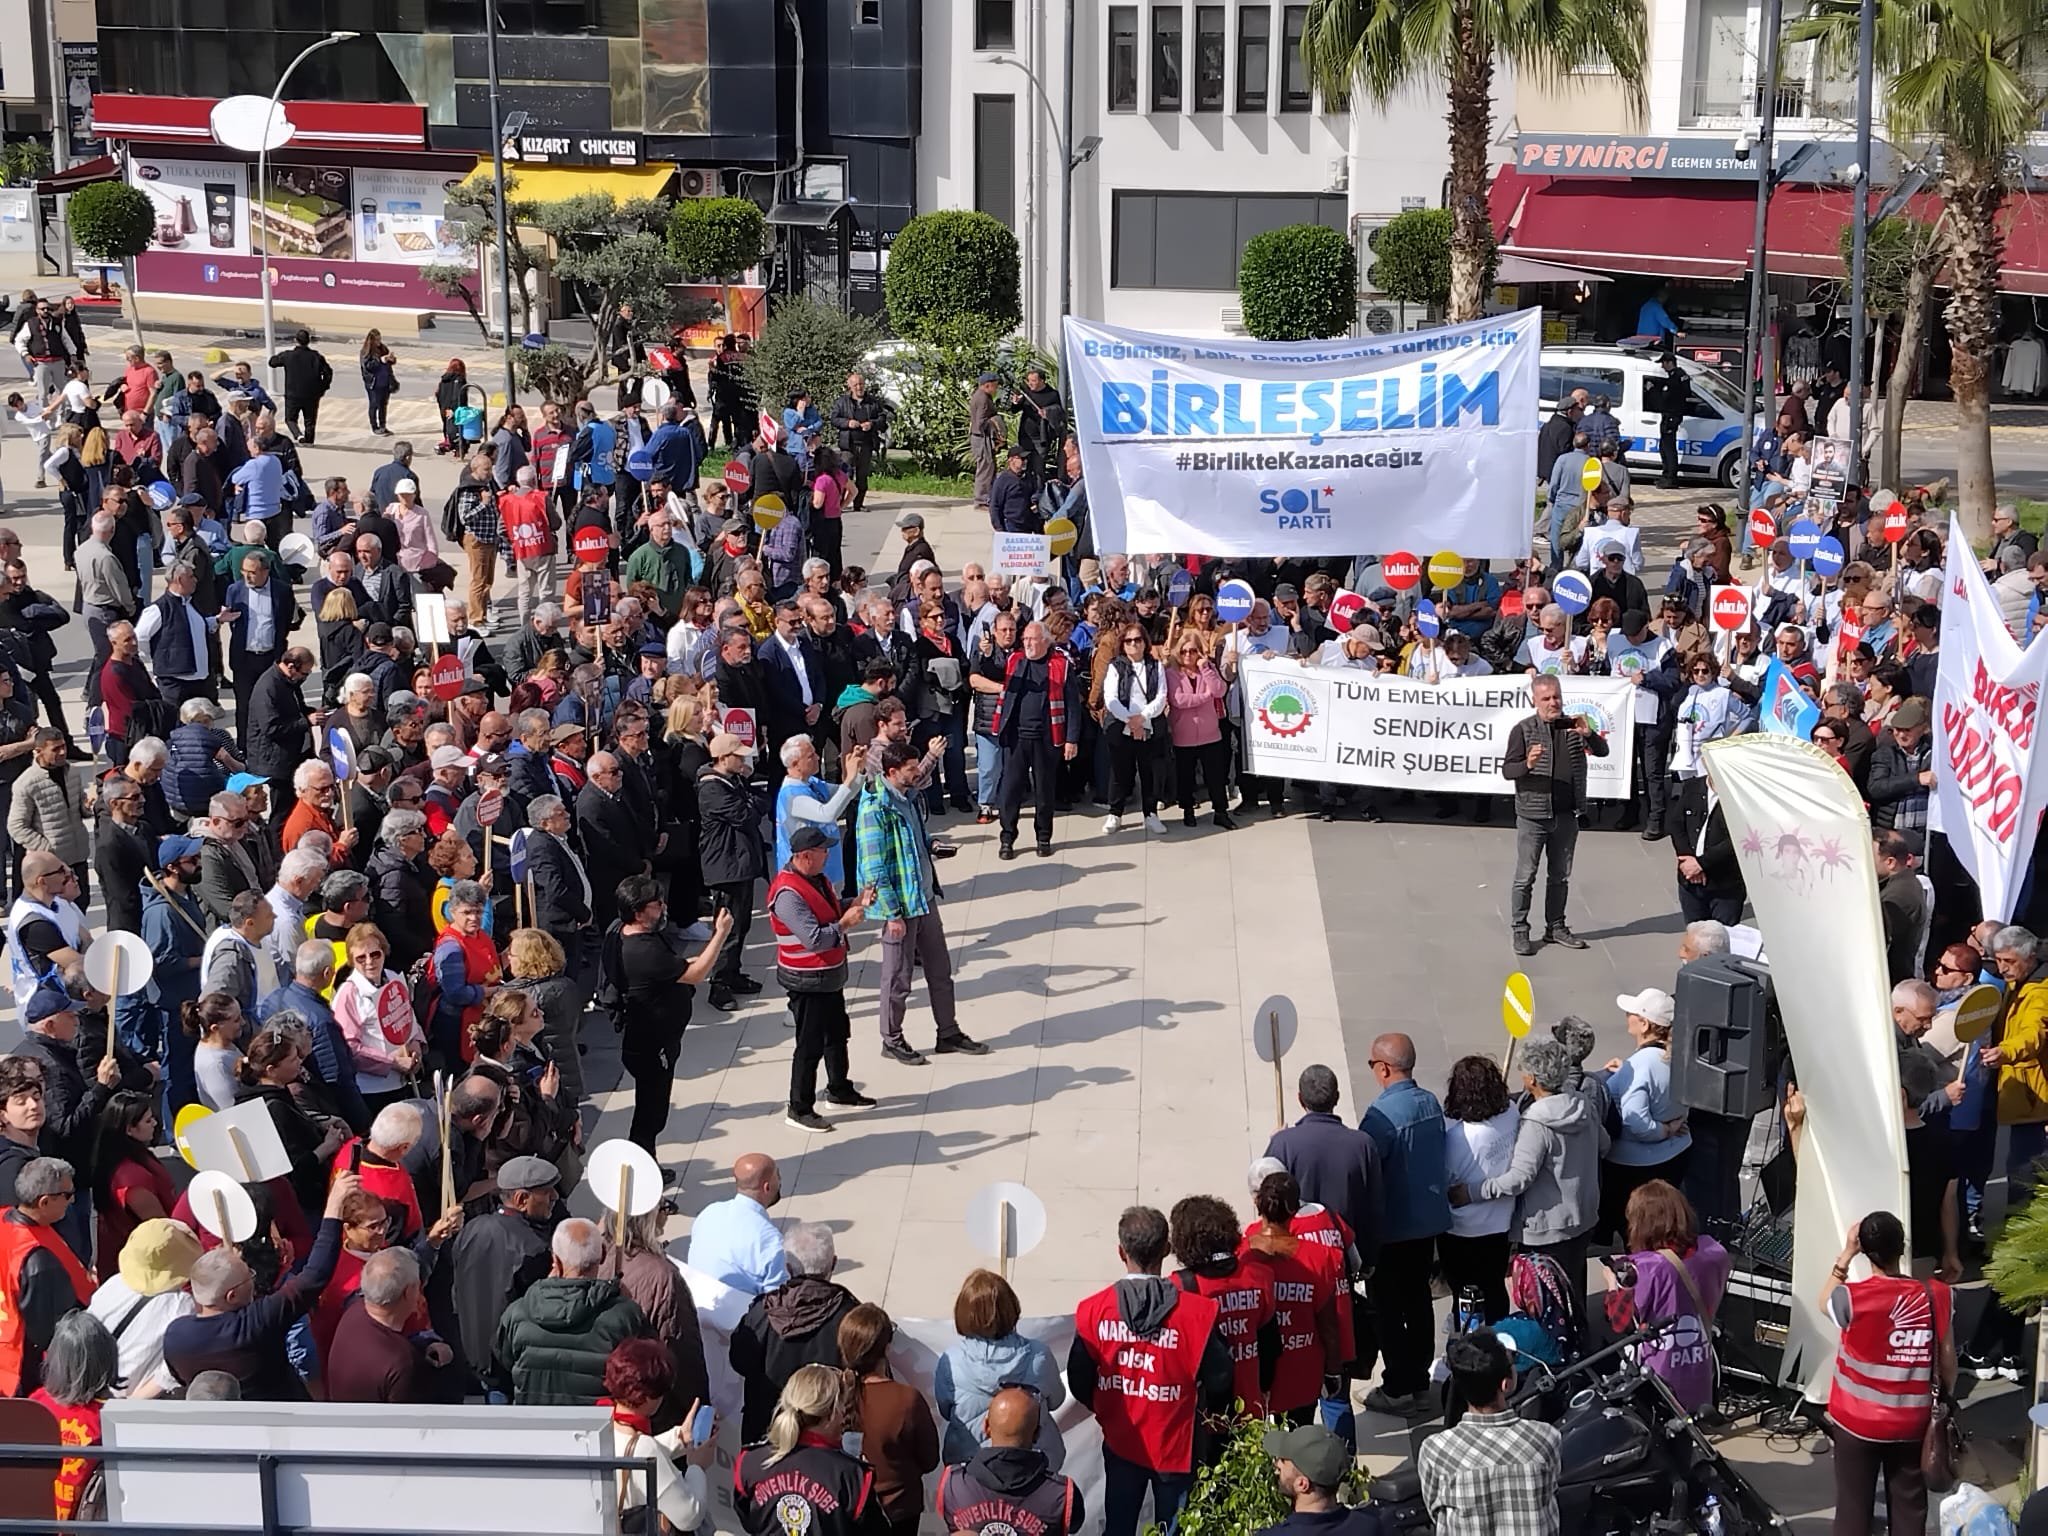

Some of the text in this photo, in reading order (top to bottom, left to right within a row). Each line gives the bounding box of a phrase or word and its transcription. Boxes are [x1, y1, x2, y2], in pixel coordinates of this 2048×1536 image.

[522, 137, 637, 156] KIZART CHICKEN
[1522, 140, 1757, 170] PEYNİRCİ EGEMEN SEYMEN
[165, 165, 237, 180] TÜRK KAHVESİ
[1084, 339, 1187, 362] Bağımsız,
[1193, 348, 1246, 362] Laik,
[1250, 347, 1384, 365] Demokratik
[1480, 328, 1519, 351] için
[1101, 362, 1501, 446] BİRLEŞELİM
[1175, 446, 1424, 471] #BirlikteKazanacağız
[1644, 437, 1703, 456] PLİS
[1259, 489, 1331, 514] SOL
[512, 523, 544, 541] SOL
[1278, 514, 1332, 529] PARTİ
[575, 535, 609, 550] LAİKLİK
[1384, 562, 1420, 577] LAİKLİK
[1713, 600, 1749, 616] LAİKLİK
[432, 668, 465, 686] LAİKLİK
[1333, 680, 1535, 709] TÜM EMEKLİLERİN
[1372, 716, 1493, 742] SENDİKASI
[1336, 745, 1396, 770] İZMİR
[1218, 1317, 1249, 1337] DİSK
[1888, 1329, 1934, 1348] CHP
[1117, 1347, 1157, 1374] DİSK
[1097, 1374, 1182, 1402] MEKLİ-SEN
[754, 1469, 841, 1515] GÜVENLİK ŞUBE
[953, 1500, 1012, 1531] GÜVENLİK
[1016, 1509, 1049, 1535] ŞUBE
